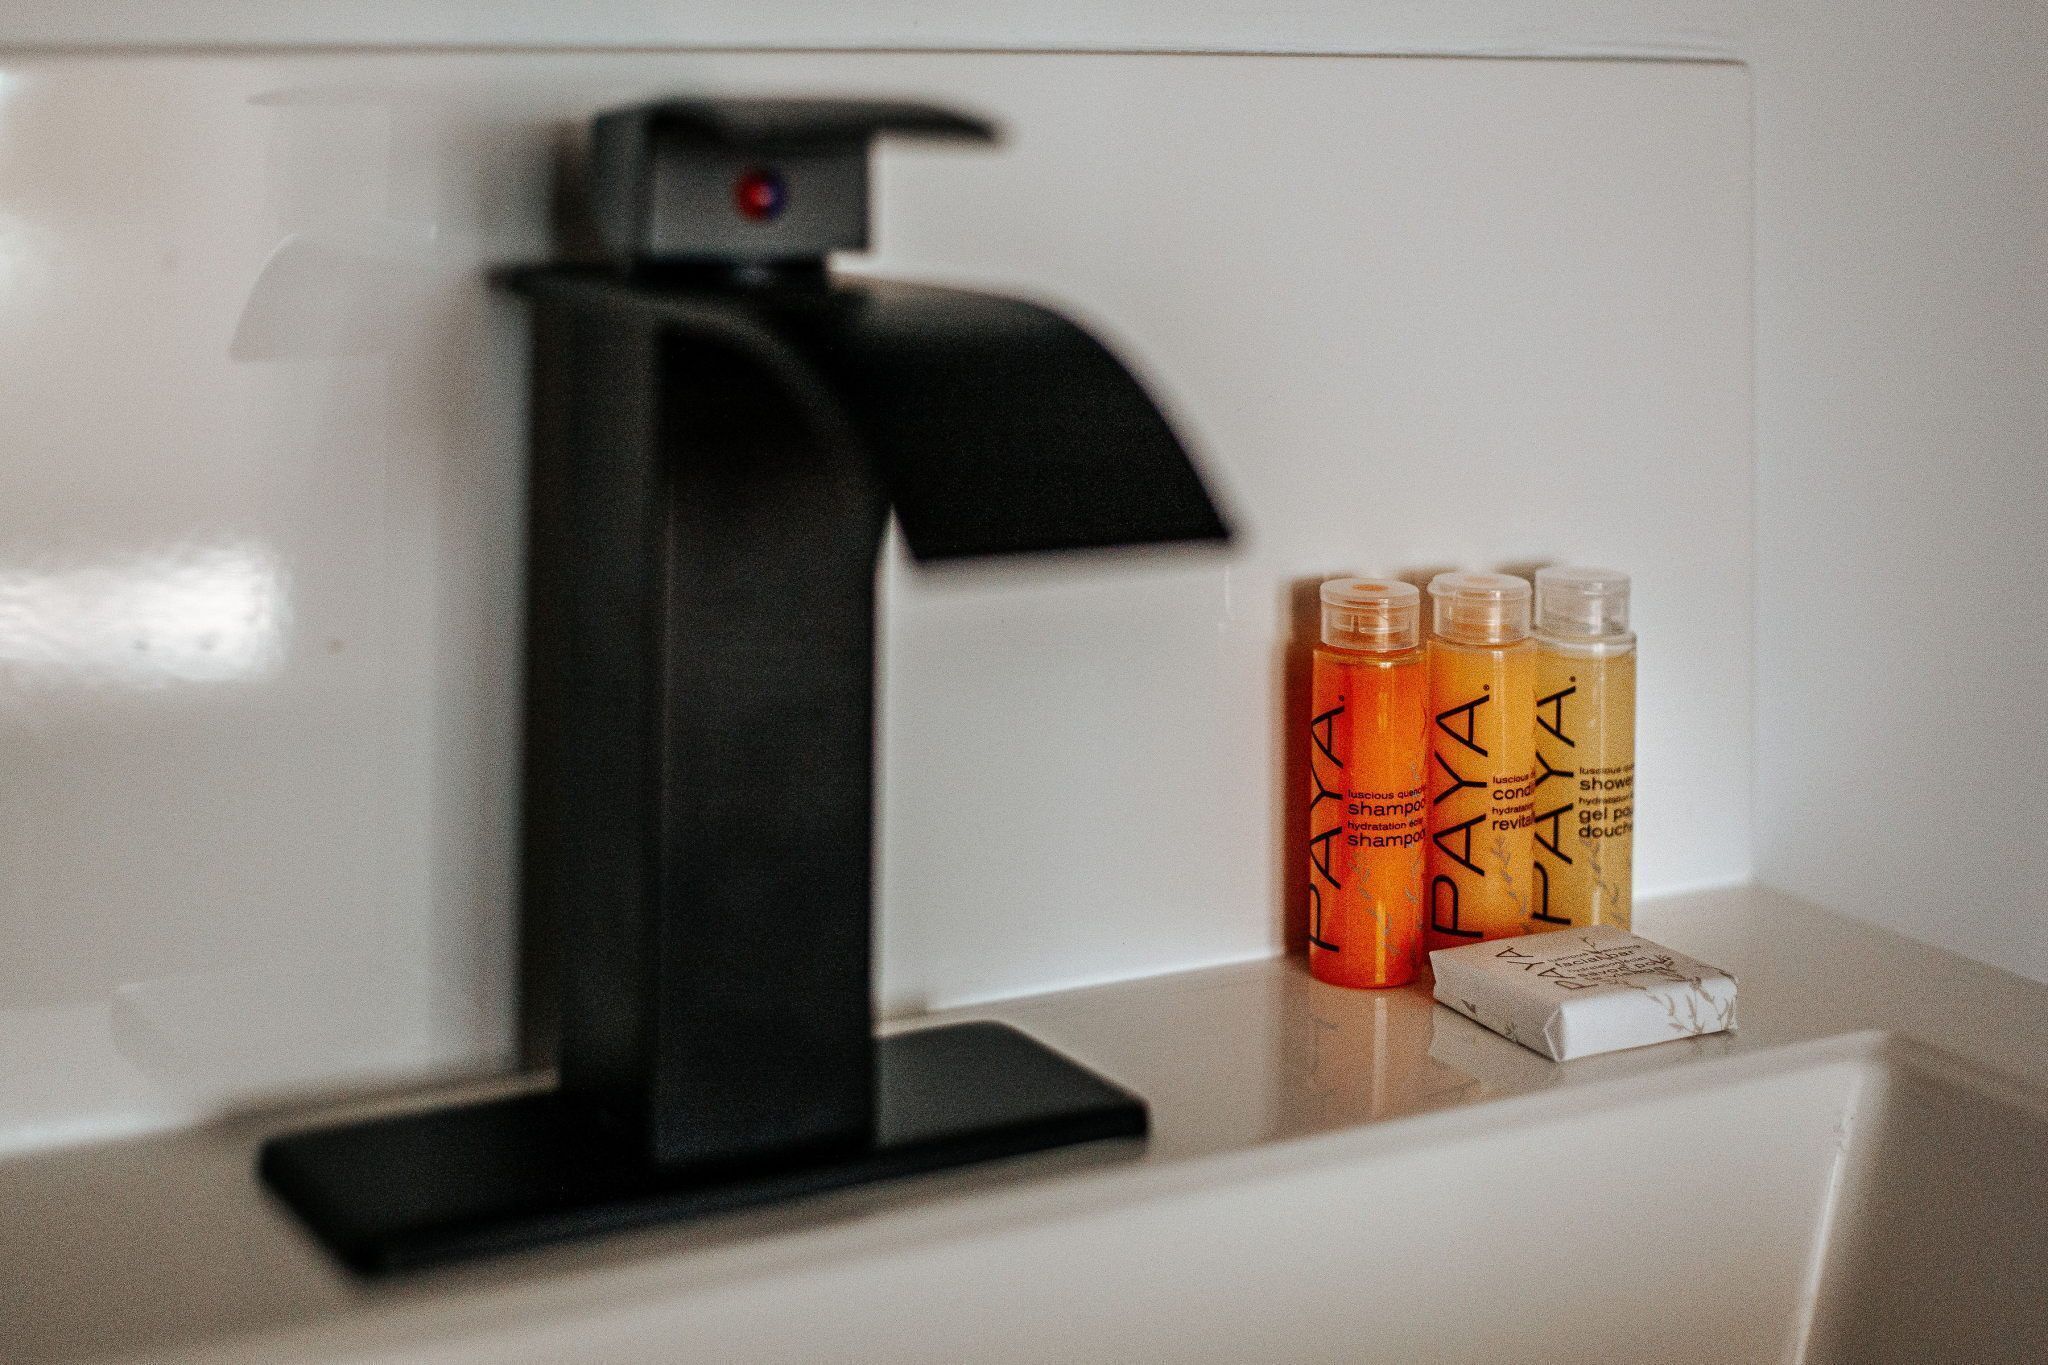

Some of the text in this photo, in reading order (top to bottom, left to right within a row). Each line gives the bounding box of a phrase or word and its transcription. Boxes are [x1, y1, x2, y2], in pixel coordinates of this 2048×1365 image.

[1580, 767, 1621, 775] luscous
[1347, 789, 1395, 800] luscious
[1533, 683, 1575, 926] PAYA
[1308, 705, 1345, 953] PAYA
[1347, 820, 1407, 832] hydratation
[1432, 695, 1490, 938] PAYA
[1579, 807, 1608, 824] gel
[1495, 947, 1600, 990] PAYA
